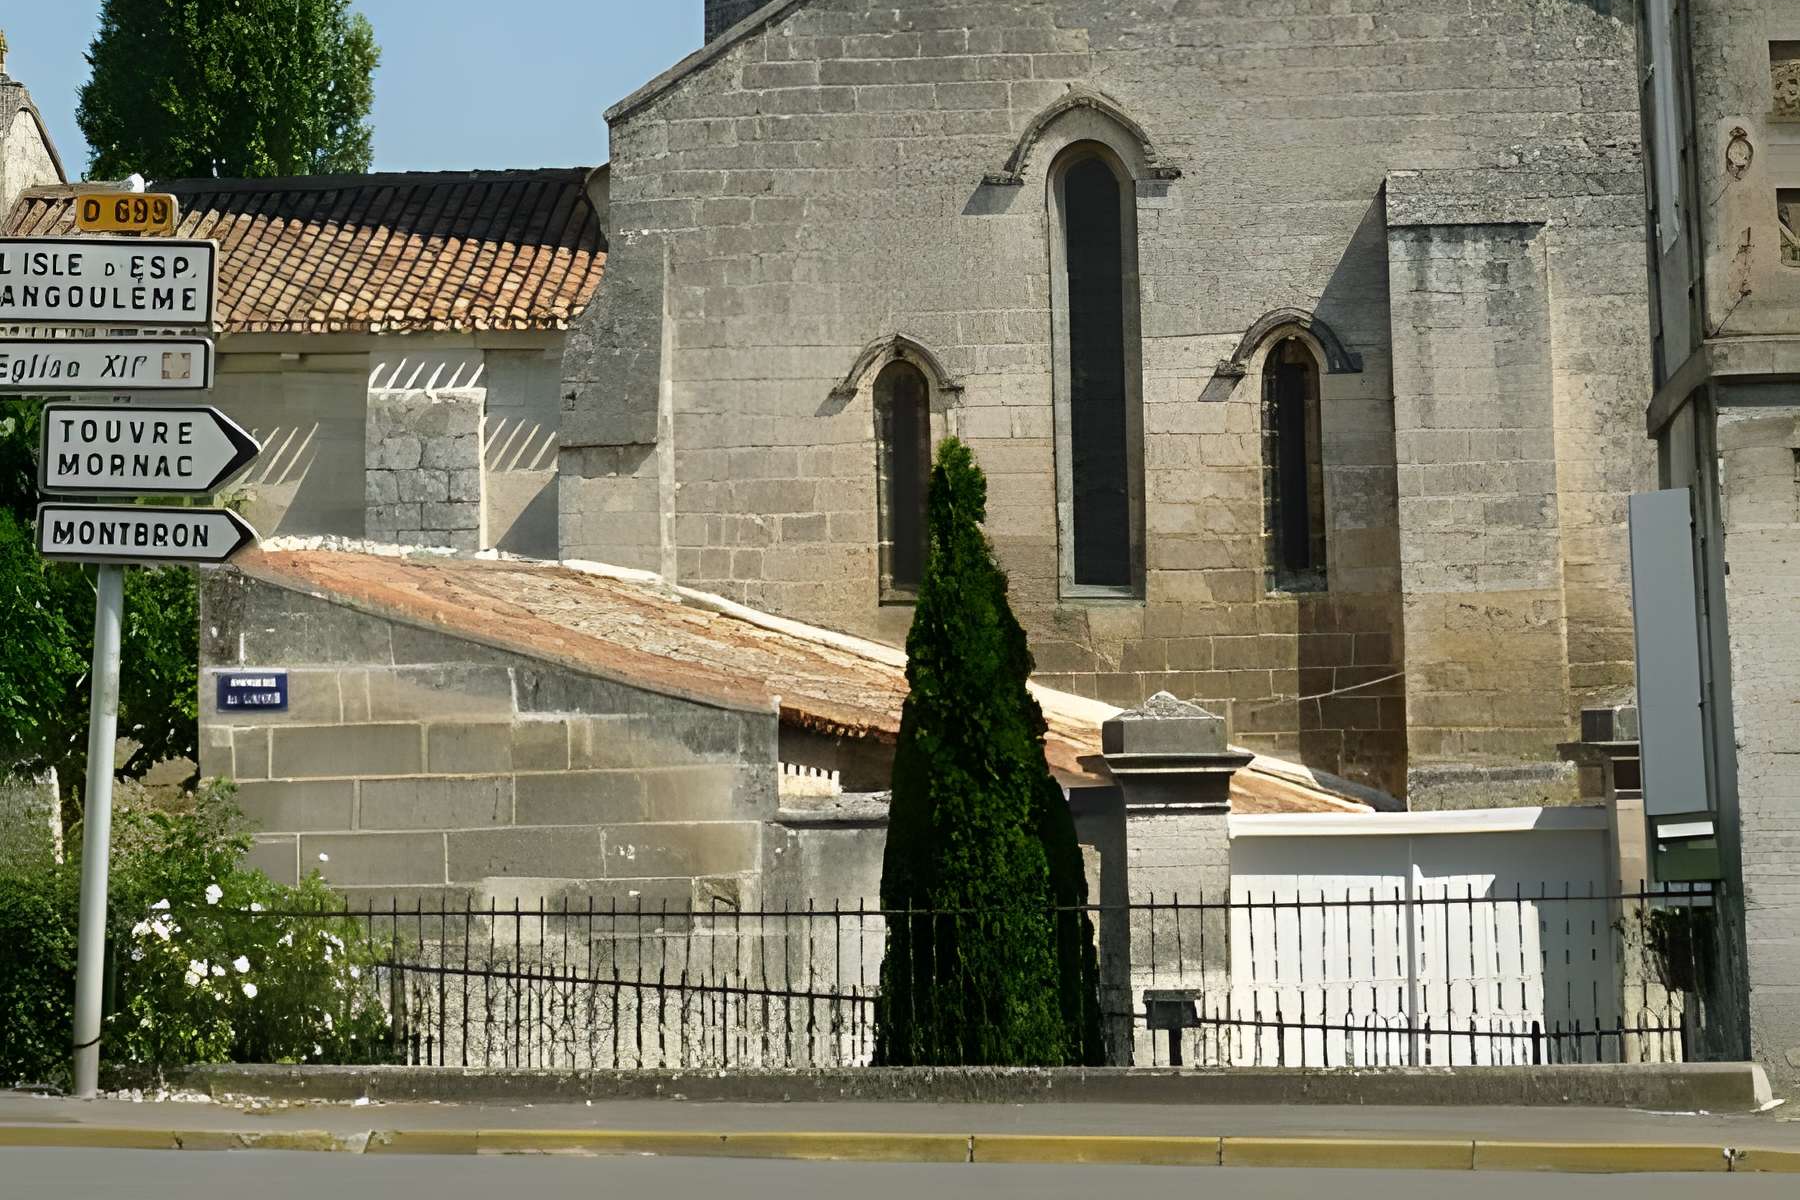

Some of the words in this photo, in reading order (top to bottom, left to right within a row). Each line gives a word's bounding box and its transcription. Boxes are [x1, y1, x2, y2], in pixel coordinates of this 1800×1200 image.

[84, 199, 100, 222] D
[115, 199, 168, 224] 699
[60, 419, 193, 445] TOUVRE
[58, 453, 193, 477] MORNAC
[53, 520, 208, 547] MONTBRON
